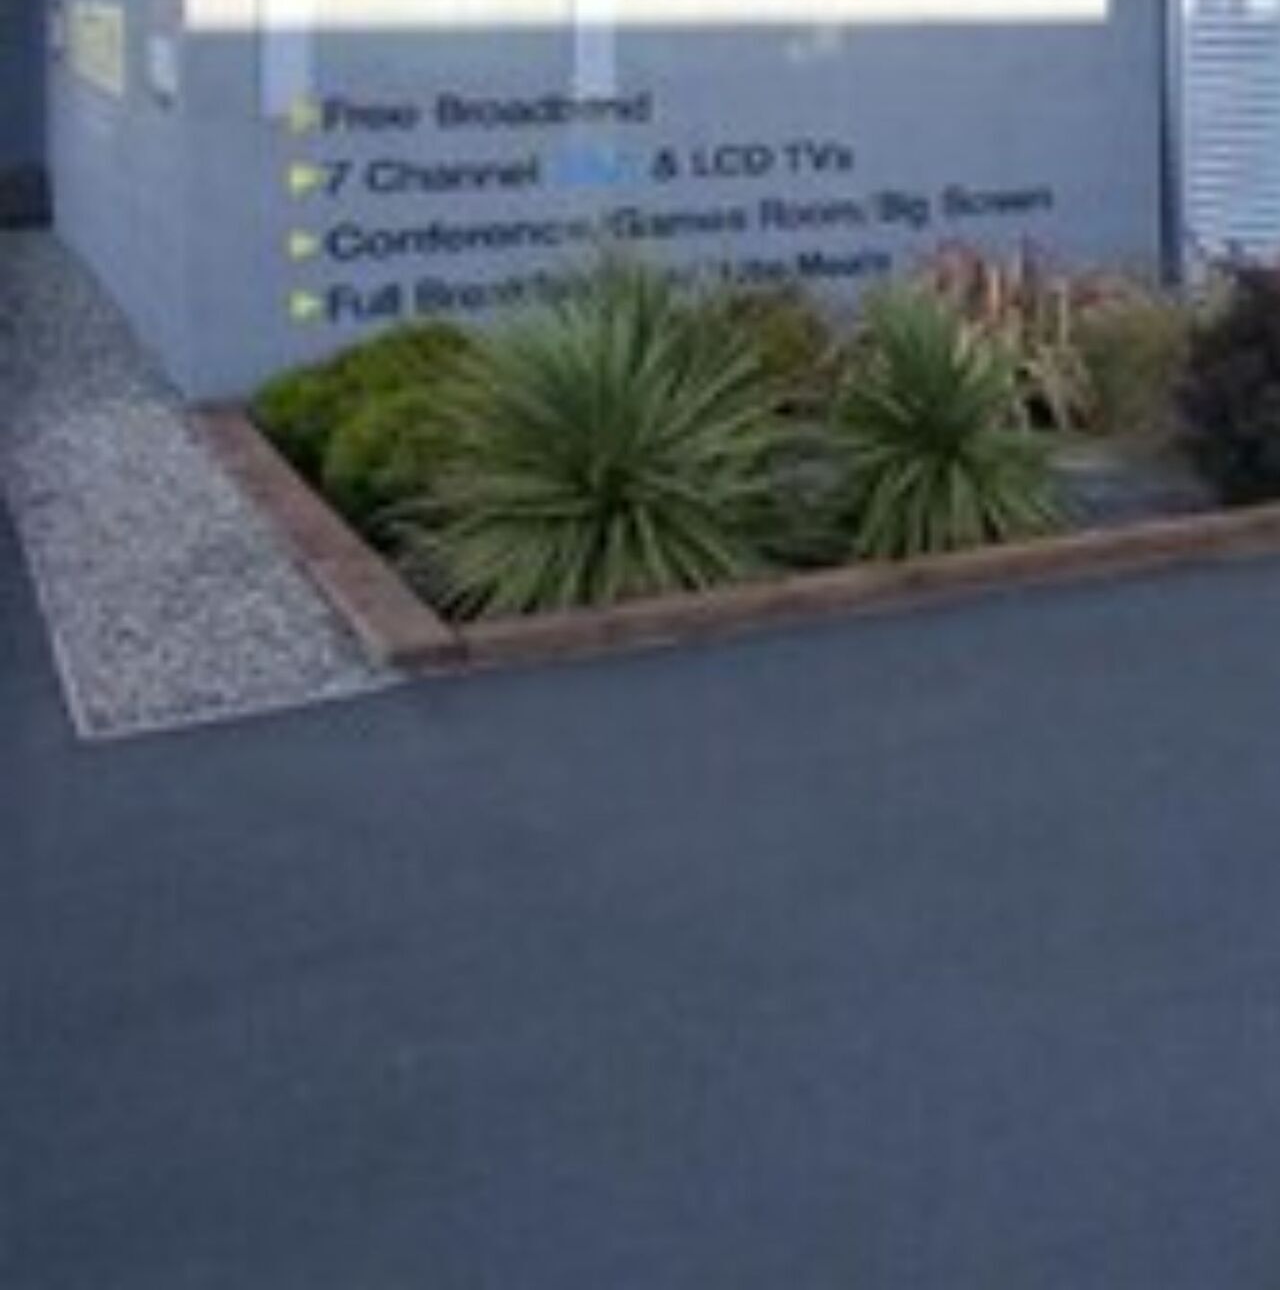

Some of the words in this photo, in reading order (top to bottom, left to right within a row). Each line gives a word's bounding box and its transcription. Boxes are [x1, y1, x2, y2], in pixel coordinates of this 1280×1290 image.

[365, 155, 540, 193] Channel
[691, 143, 774, 178] LCD
[785, 139, 853, 173] TVs
